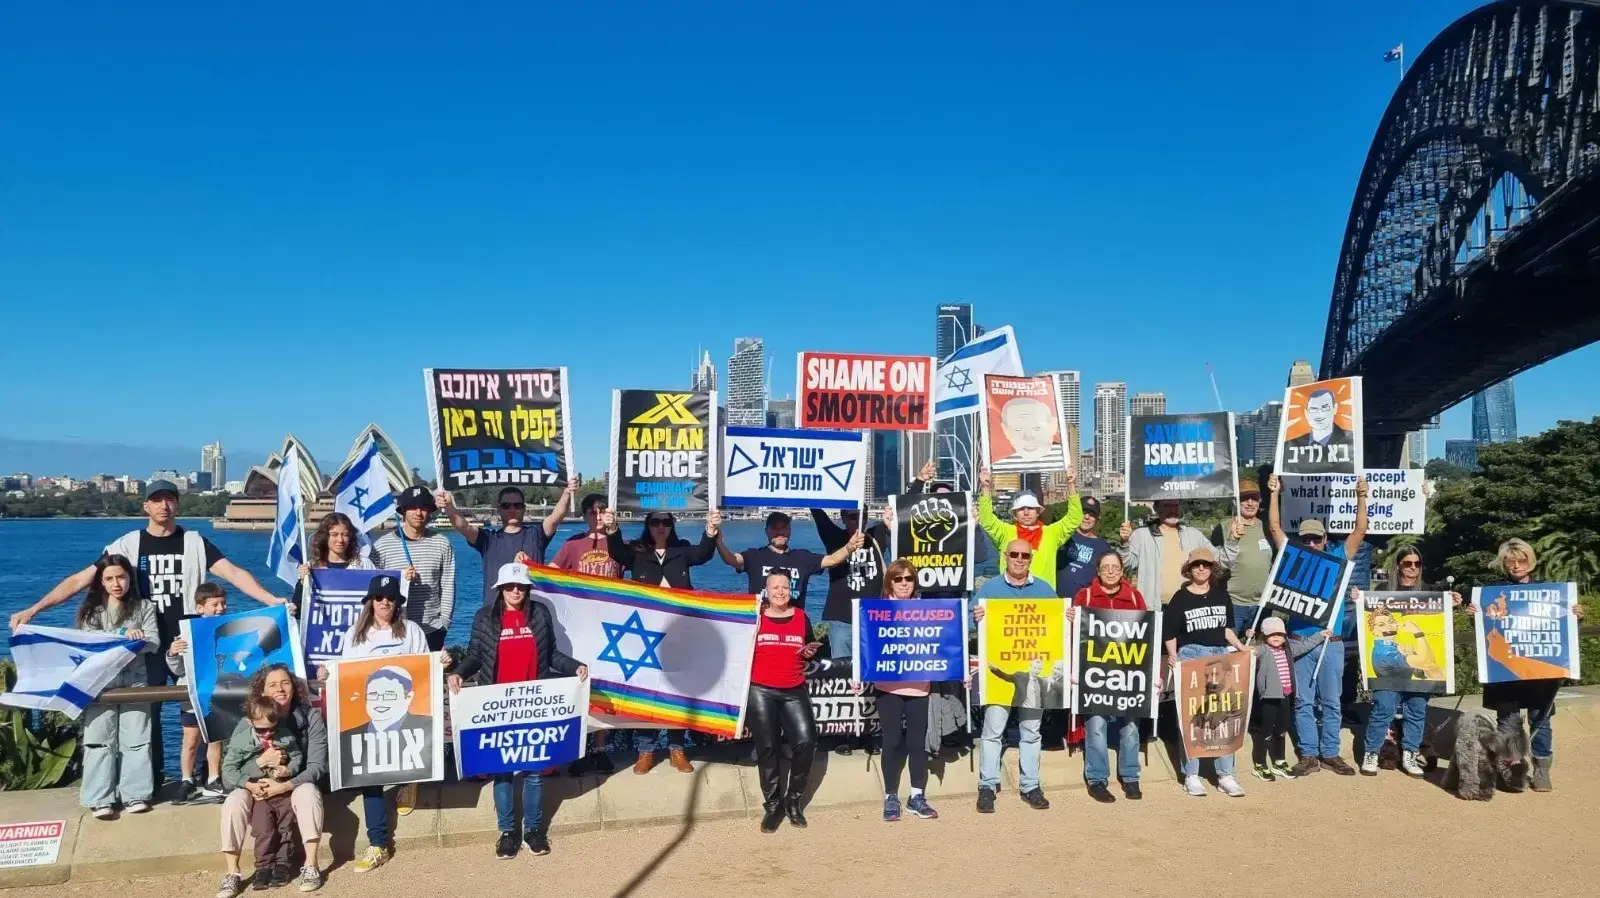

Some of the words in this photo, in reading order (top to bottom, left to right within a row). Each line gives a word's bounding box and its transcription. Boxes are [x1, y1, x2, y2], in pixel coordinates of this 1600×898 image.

[807, 358, 885, 391] SHAME
[889, 361, 925, 393] ON
[439, 373, 500, 400] איתכם
[506, 373, 553, 400] סידני
[806, 392, 924, 425] SMOTRICH
[442, 407, 477, 446] כאן
[481, 410, 505, 440] זה
[510, 404, 556, 447] קפלן
[1143, 423, 1215, 443] SAVING
[626, 427, 704, 450] KAPLAN
[448, 448, 559, 472] חובה
[760, 442, 824, 469] ישראל
[1144, 441, 1215, 465] ISRAELI
[1287, 443, 1323, 463] לריב
[1327, 444, 1350, 463] בא
[625, 450, 702, 478] FORCE
[449, 469, 559, 487] להתנגד
[758, 472, 822, 493] מתפרקת
[1366, 470, 1406, 485] accept
[1290, 485, 1319, 498] what
[1321, 485, 1325, 498] I
[1372, 486, 1416, 501] change
[1310, 502, 1314, 514] I
[1316, 505, 1334, 514] am
[1338, 502, 1394, 517] chaging
[1374, 519, 1414, 532] accept
[917, 566, 964, 588] OW
[1270, 584, 1329, 619] להתנג
[1366, 596, 1385, 609] We
[1386, 596, 1408, 609] Can
[1409, 597, 1427, 609] Do
[1510, 589, 1560, 603] מלשכת
[867, 609, 892, 621] THE
[893, 609, 955, 622] ACCUSED
[1013, 603, 1037, 613] אני
[1528, 602, 1560, 618] ראש
[1004, 614, 1046, 625] ואתה
[1088, 613, 1148, 640] how
[1501, 614, 1561, 631] הממשלה
[878, 626, 911, 638] DOES
[913, 626, 943, 638] NOT
[1503, 629, 1561, 644] מבקשים
[881, 643, 940, 655] APPOINT
[1012, 639, 1037, 649] את
[1086, 639, 1148, 665] LAW
[1000, 651, 1050, 661] העולם
[875, 660, 896, 672] HIS
[897, 659, 948, 675] JUDGES
[1190, 664, 1241, 689] ALT
[1084, 667, 1146, 692] can
[505, 687, 514, 697] IF
[517, 684, 542, 696] THE
[482, 694, 565, 711] COURTHOUSE
[1083, 693, 1114, 707] you
[1117, 694, 1146, 711] go?
[1188, 690, 1243, 716] RIGHT
[471, 711, 507, 724] CAN'T
[509, 708, 548, 722] JUDGE
[551, 705, 575, 717] YOU
[479, 724, 570, 750] HISTORY
[1190, 718, 1241, 741] LAND
[351, 728, 425, 775] אש!
[500, 744, 552, 764] WILL
